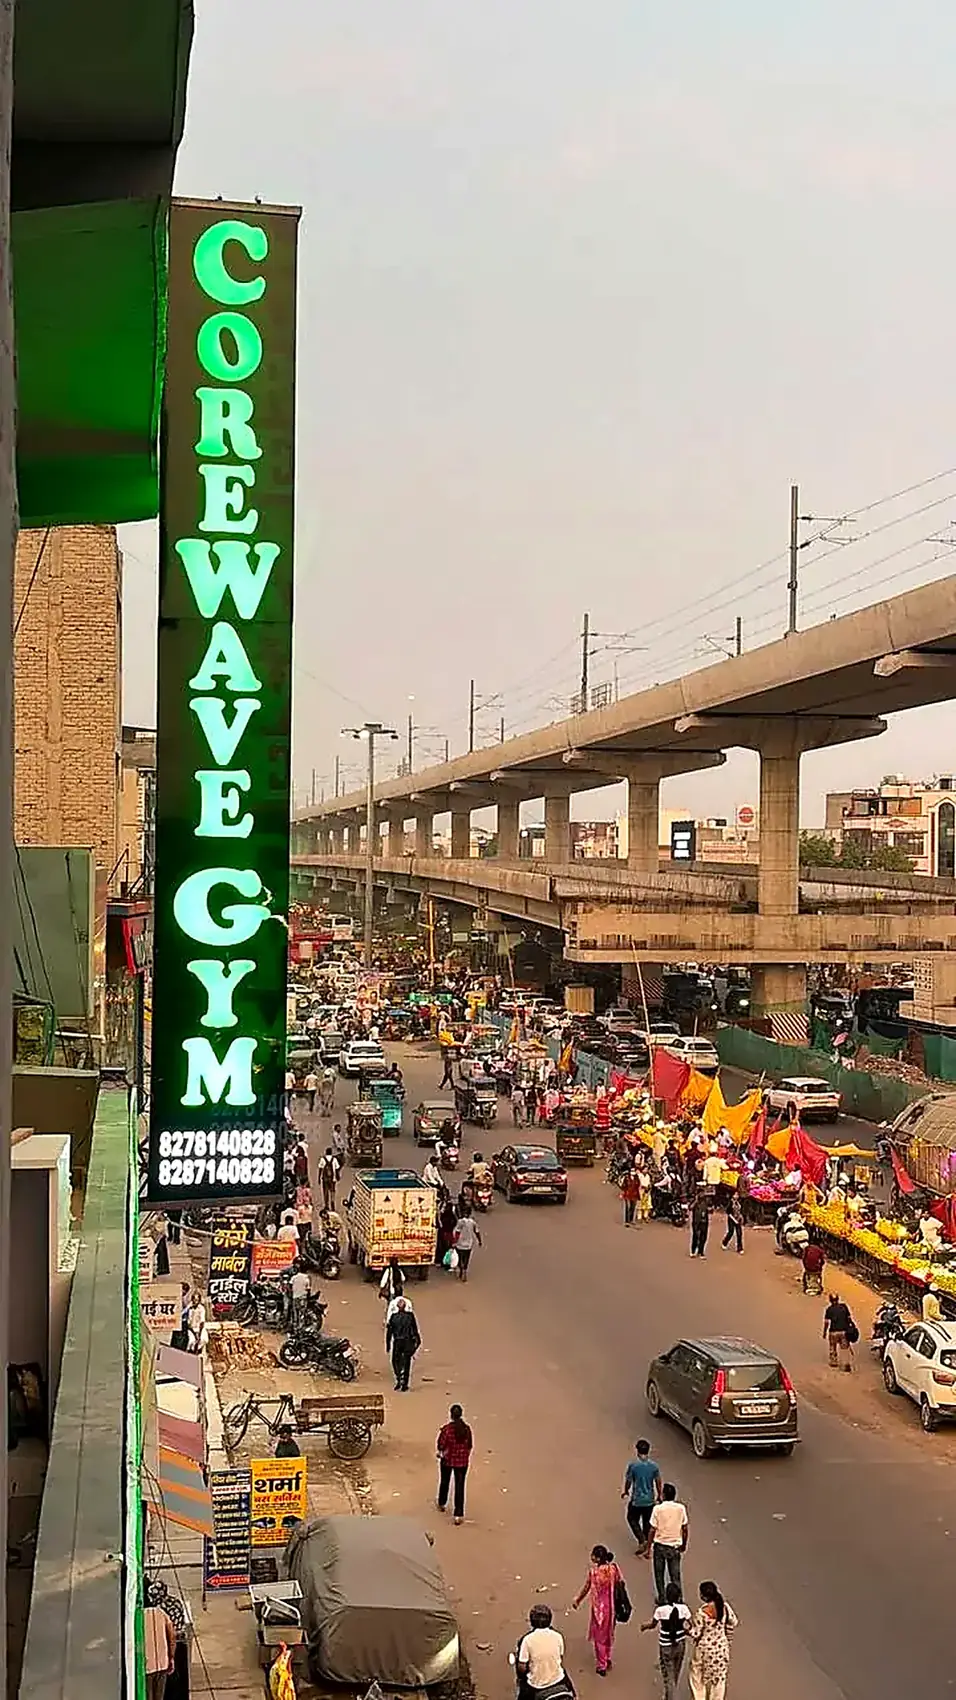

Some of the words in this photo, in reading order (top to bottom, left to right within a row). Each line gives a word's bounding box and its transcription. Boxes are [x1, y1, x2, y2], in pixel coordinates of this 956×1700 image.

[174, 867, 272, 1107] GYM
[158, 1130, 276, 1158] 8278140828
[158, 1157, 276, 1185] 8287140828
[254, 1471, 302, 1493] शर्मा
